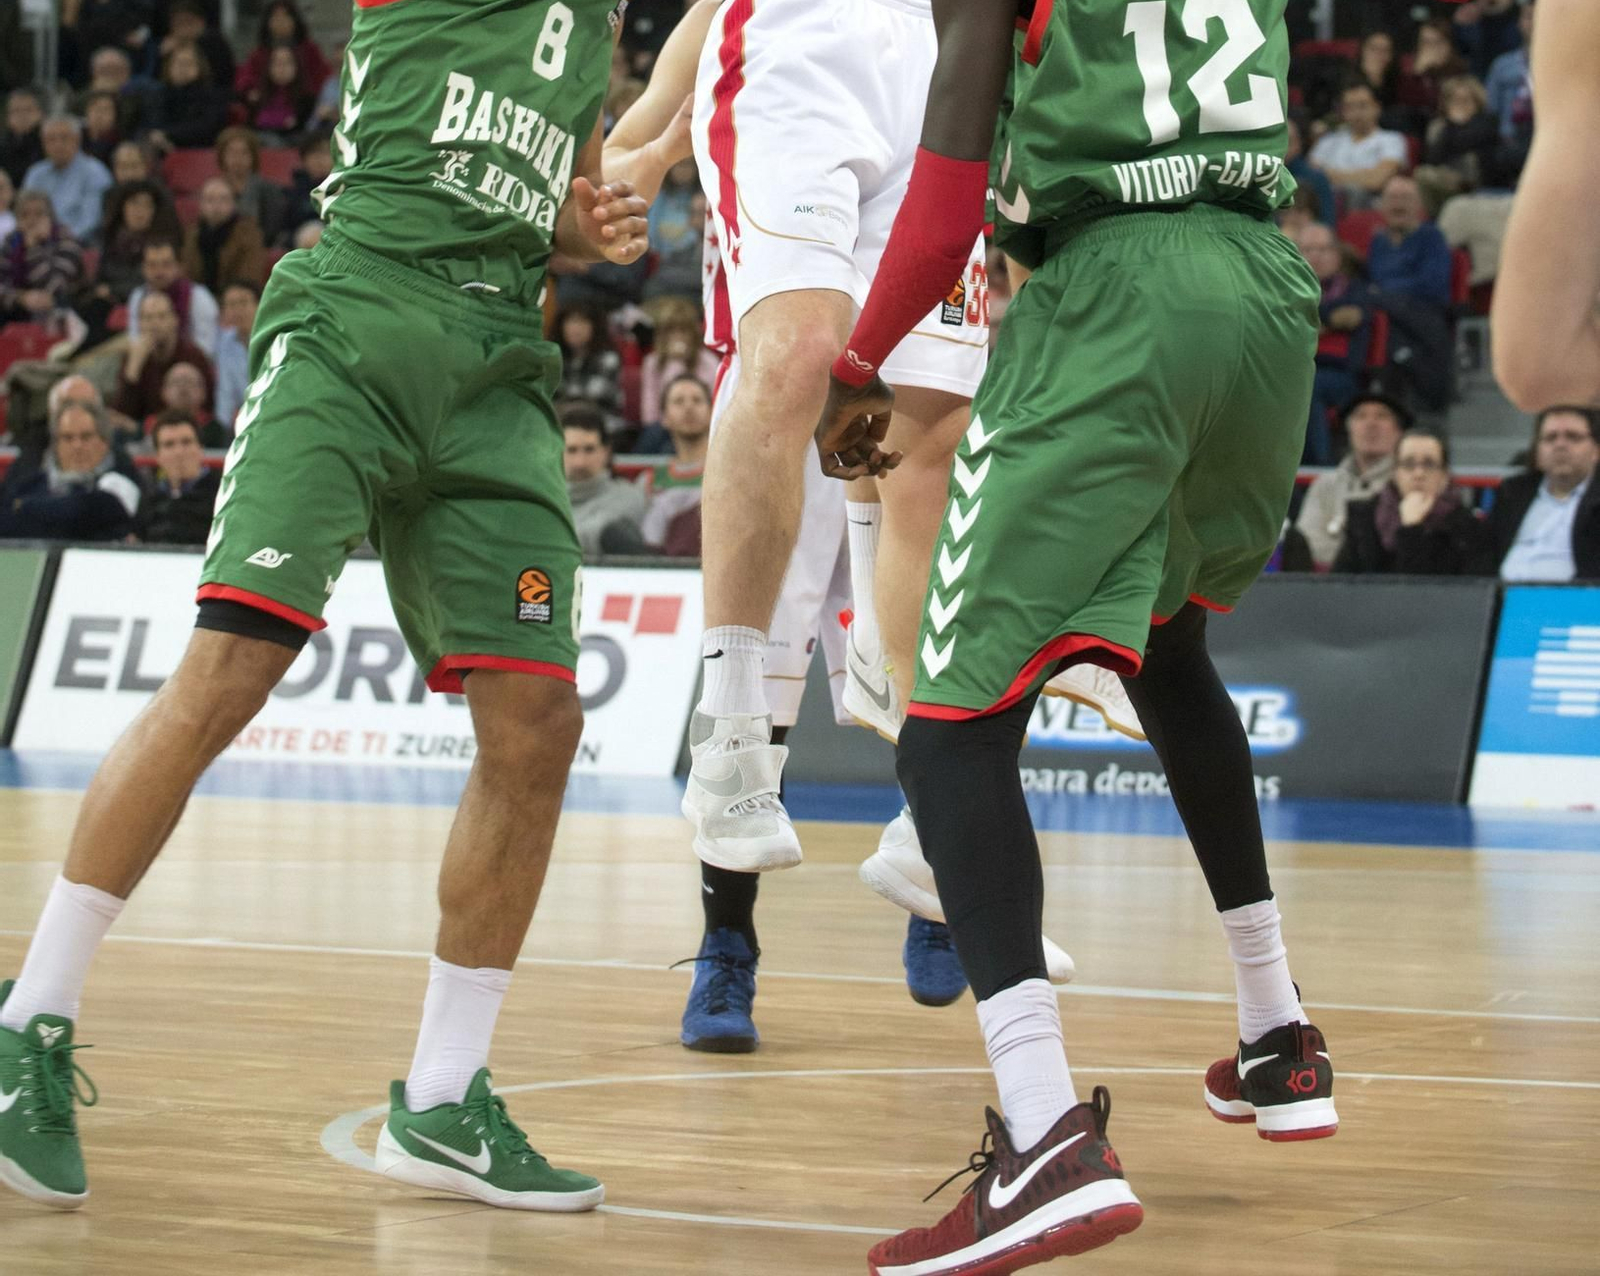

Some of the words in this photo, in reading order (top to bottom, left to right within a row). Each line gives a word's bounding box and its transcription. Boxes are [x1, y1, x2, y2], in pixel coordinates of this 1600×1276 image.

[532, 1, 575, 82] 8
[54, 616, 172, 691] EL
[361, 732, 387, 756] TI
